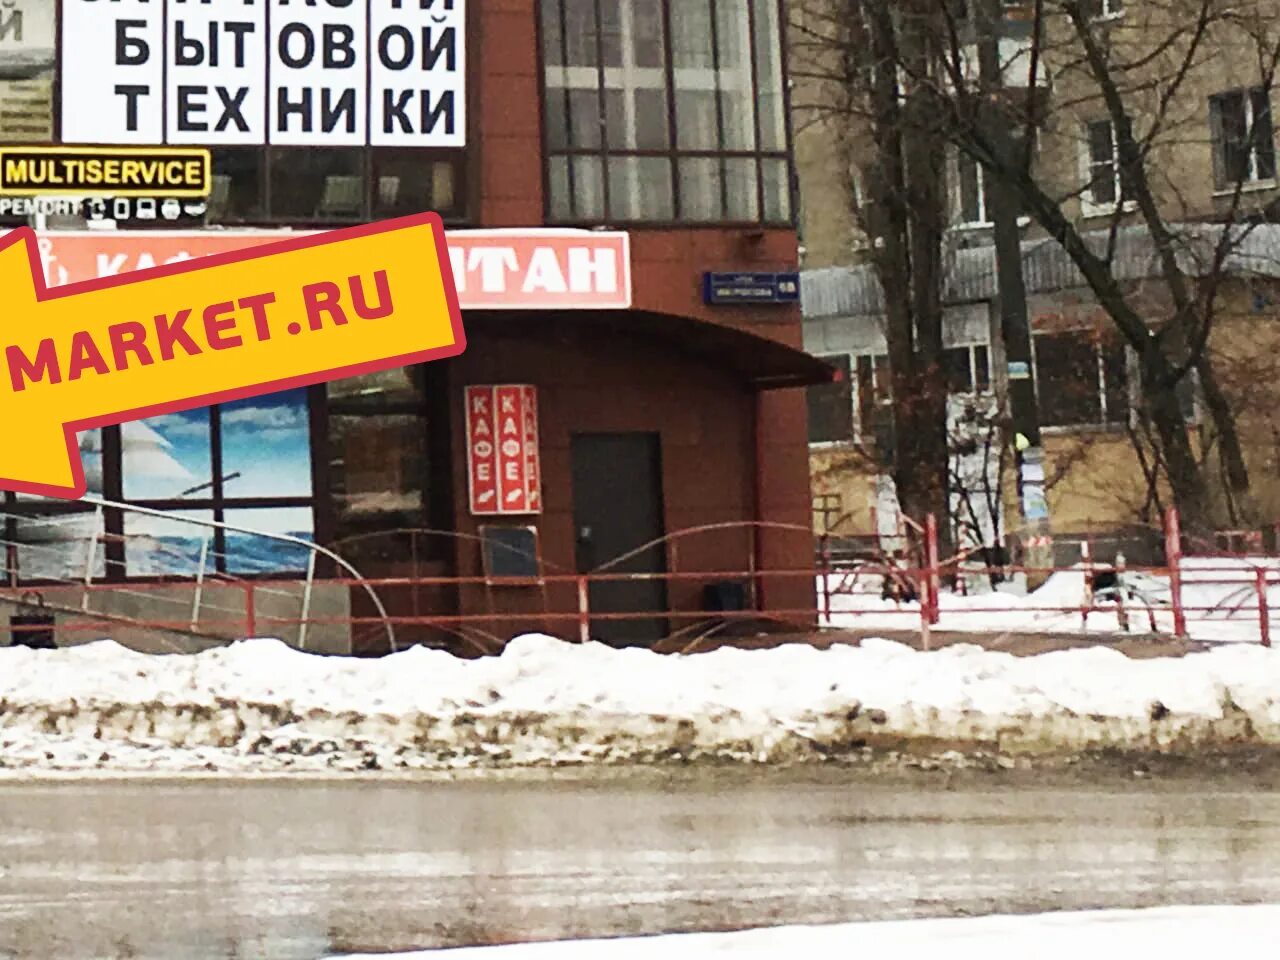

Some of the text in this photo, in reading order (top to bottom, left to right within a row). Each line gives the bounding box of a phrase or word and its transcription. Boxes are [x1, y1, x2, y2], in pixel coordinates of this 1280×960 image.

[115, 14, 457, 72] БЫТОВОЙ
[115, 85, 455, 135] ТЕХНИКИ
[6, 160, 201, 185] MULTISERVICE
